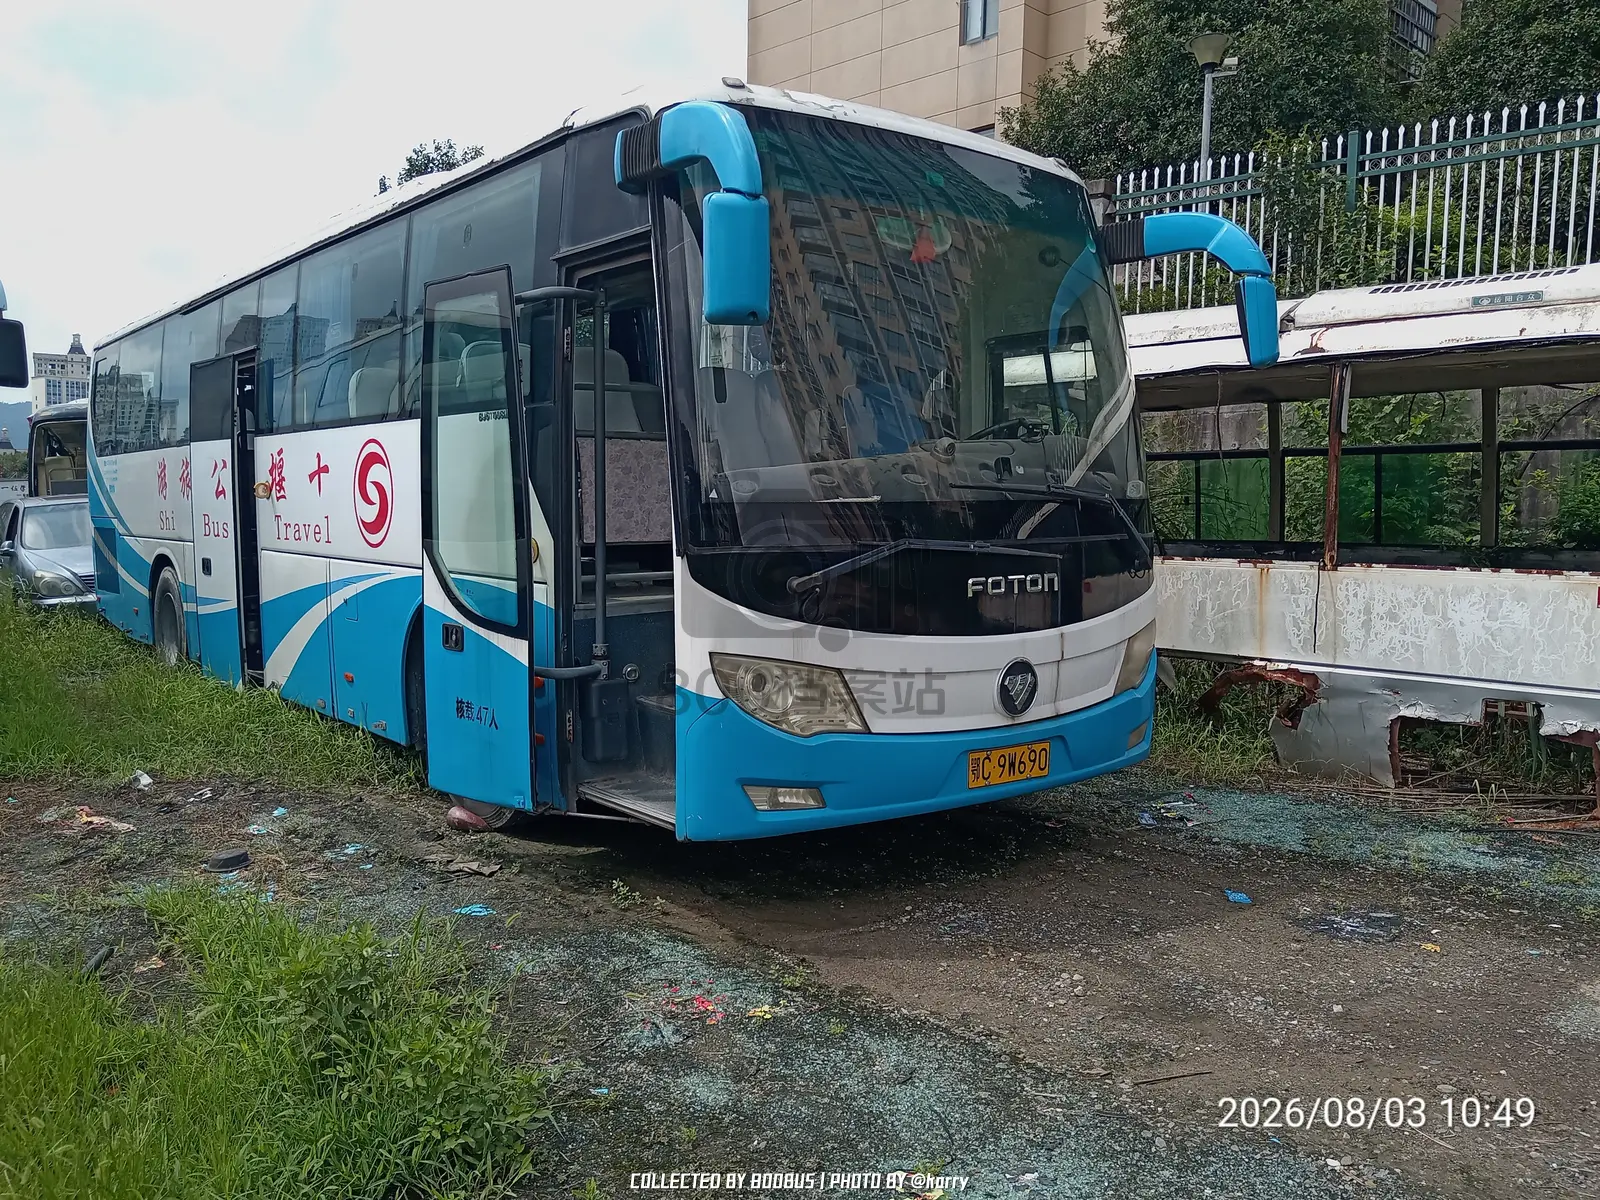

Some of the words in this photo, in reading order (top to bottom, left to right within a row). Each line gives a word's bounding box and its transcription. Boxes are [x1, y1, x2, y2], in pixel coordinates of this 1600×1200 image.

[159, 510, 176, 531] Shi
[203, 513, 229, 539] Bus
[274, 514, 332, 544] Travel
[968, 572, 1059, 598] FOTON
